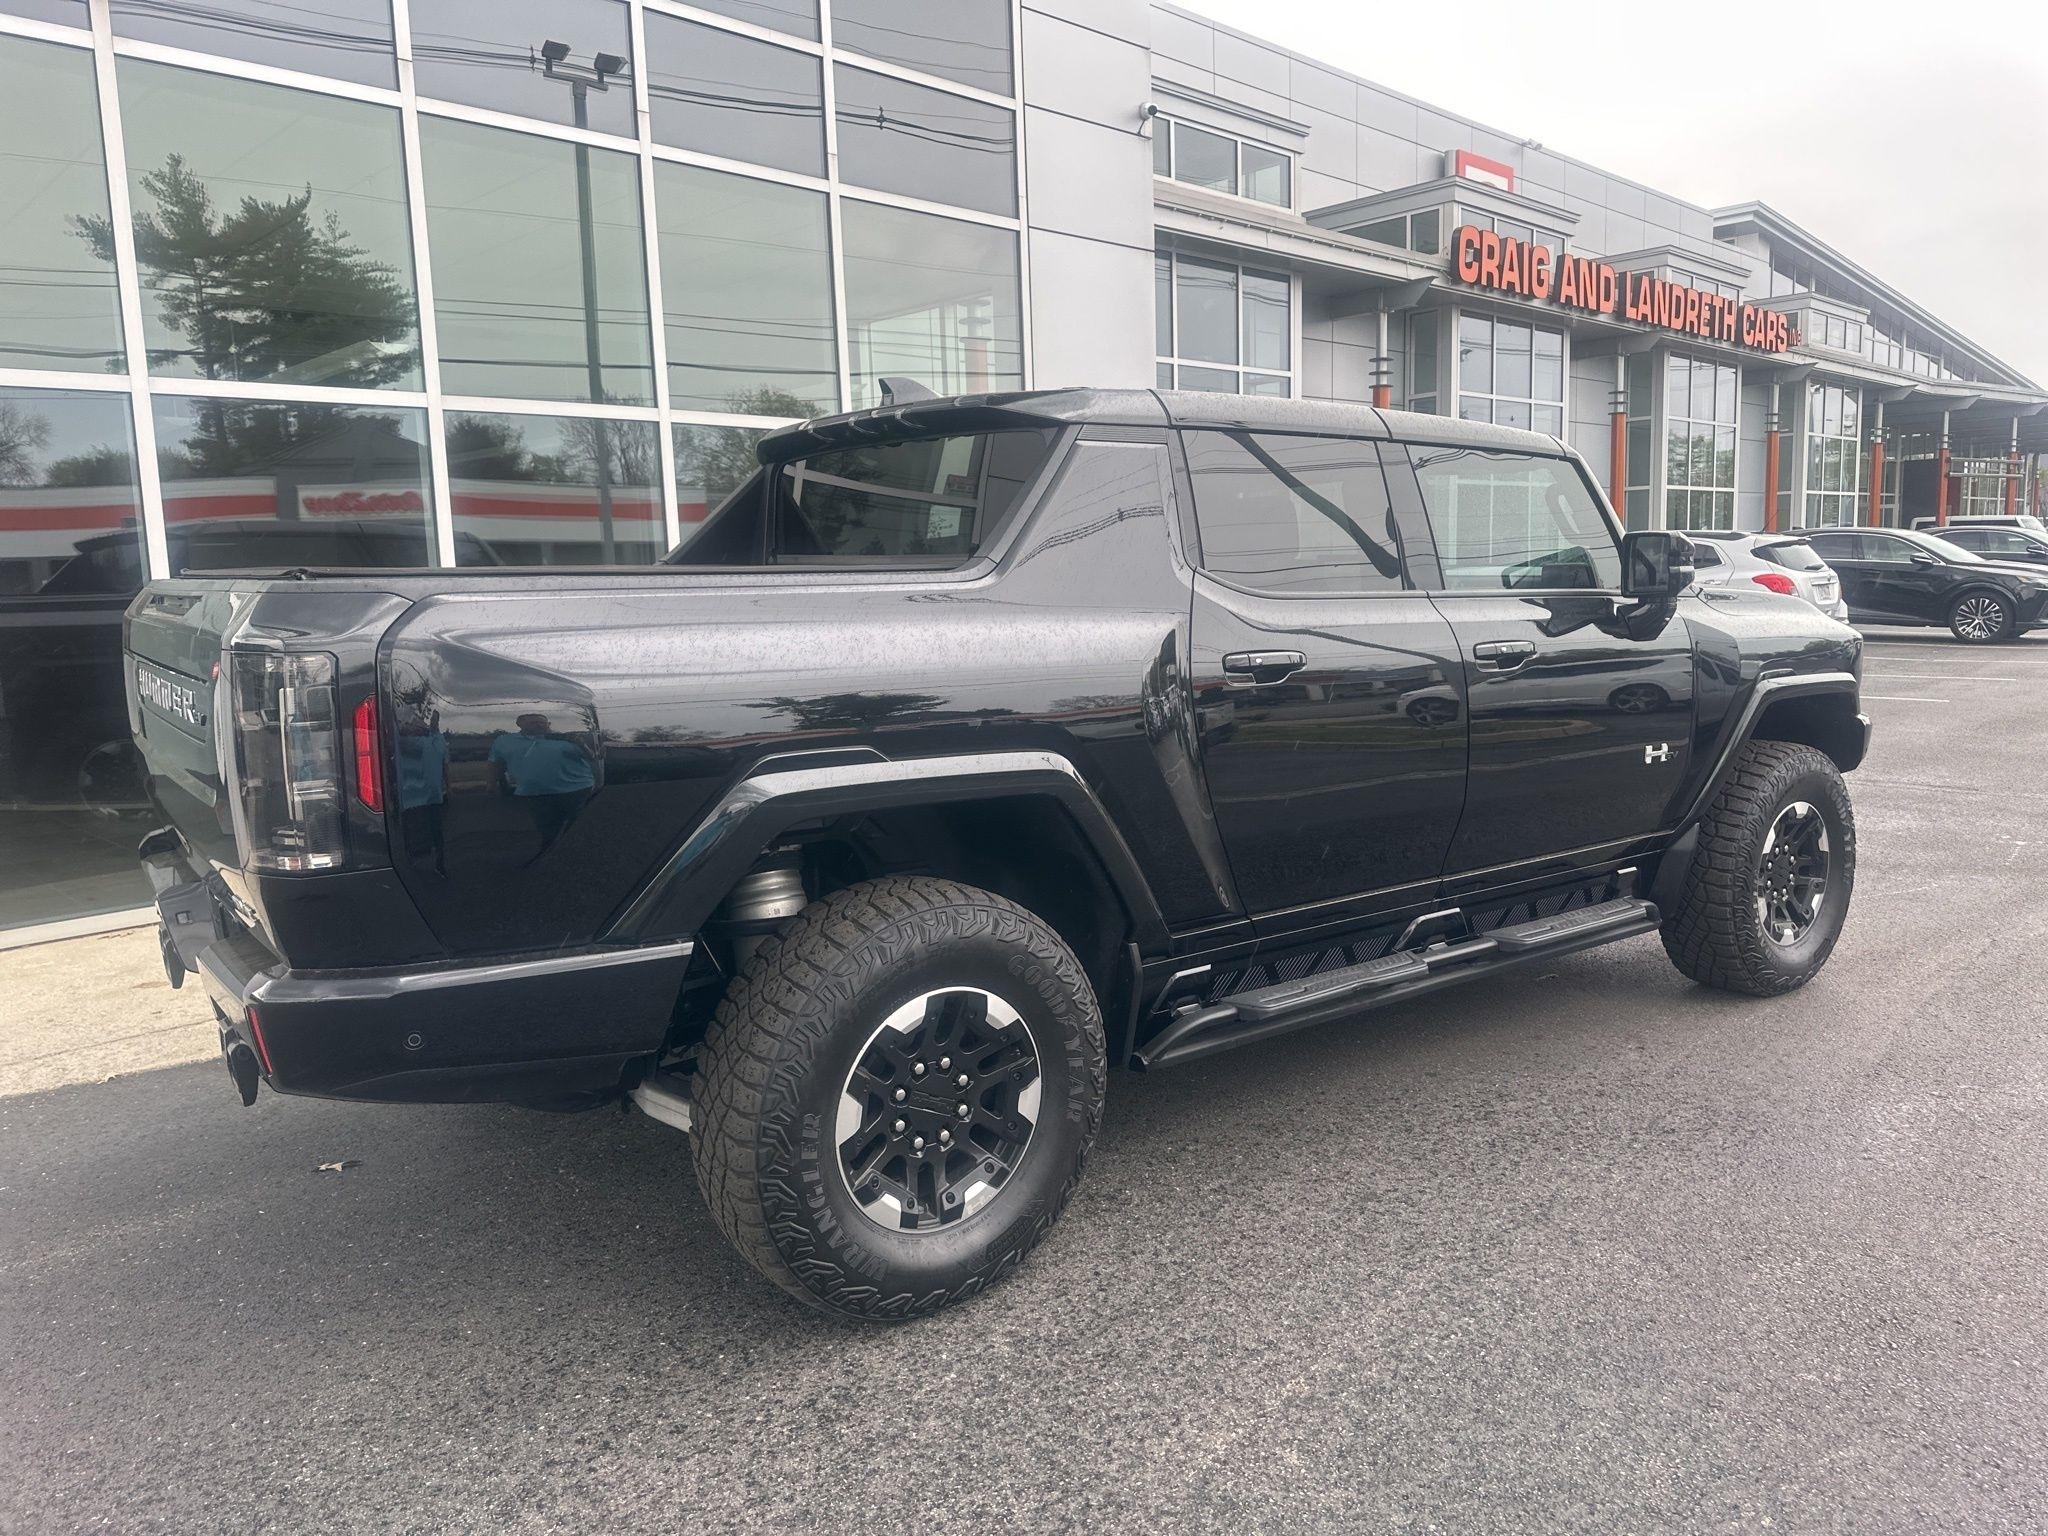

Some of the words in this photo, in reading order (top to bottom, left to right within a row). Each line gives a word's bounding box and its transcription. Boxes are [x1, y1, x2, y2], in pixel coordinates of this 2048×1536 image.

[1456, 224, 1550, 299] CRAIG
[1559, 253, 1616, 314] AND
[1626, 271, 1736, 342] LANDRETH
[1743, 304, 1788, 353] CARS
[138, 668, 195, 724] HUMMER
[1007, 954, 1086, 1123] GOODYEAR
[801, 1112, 889, 1282] WRANGLER
